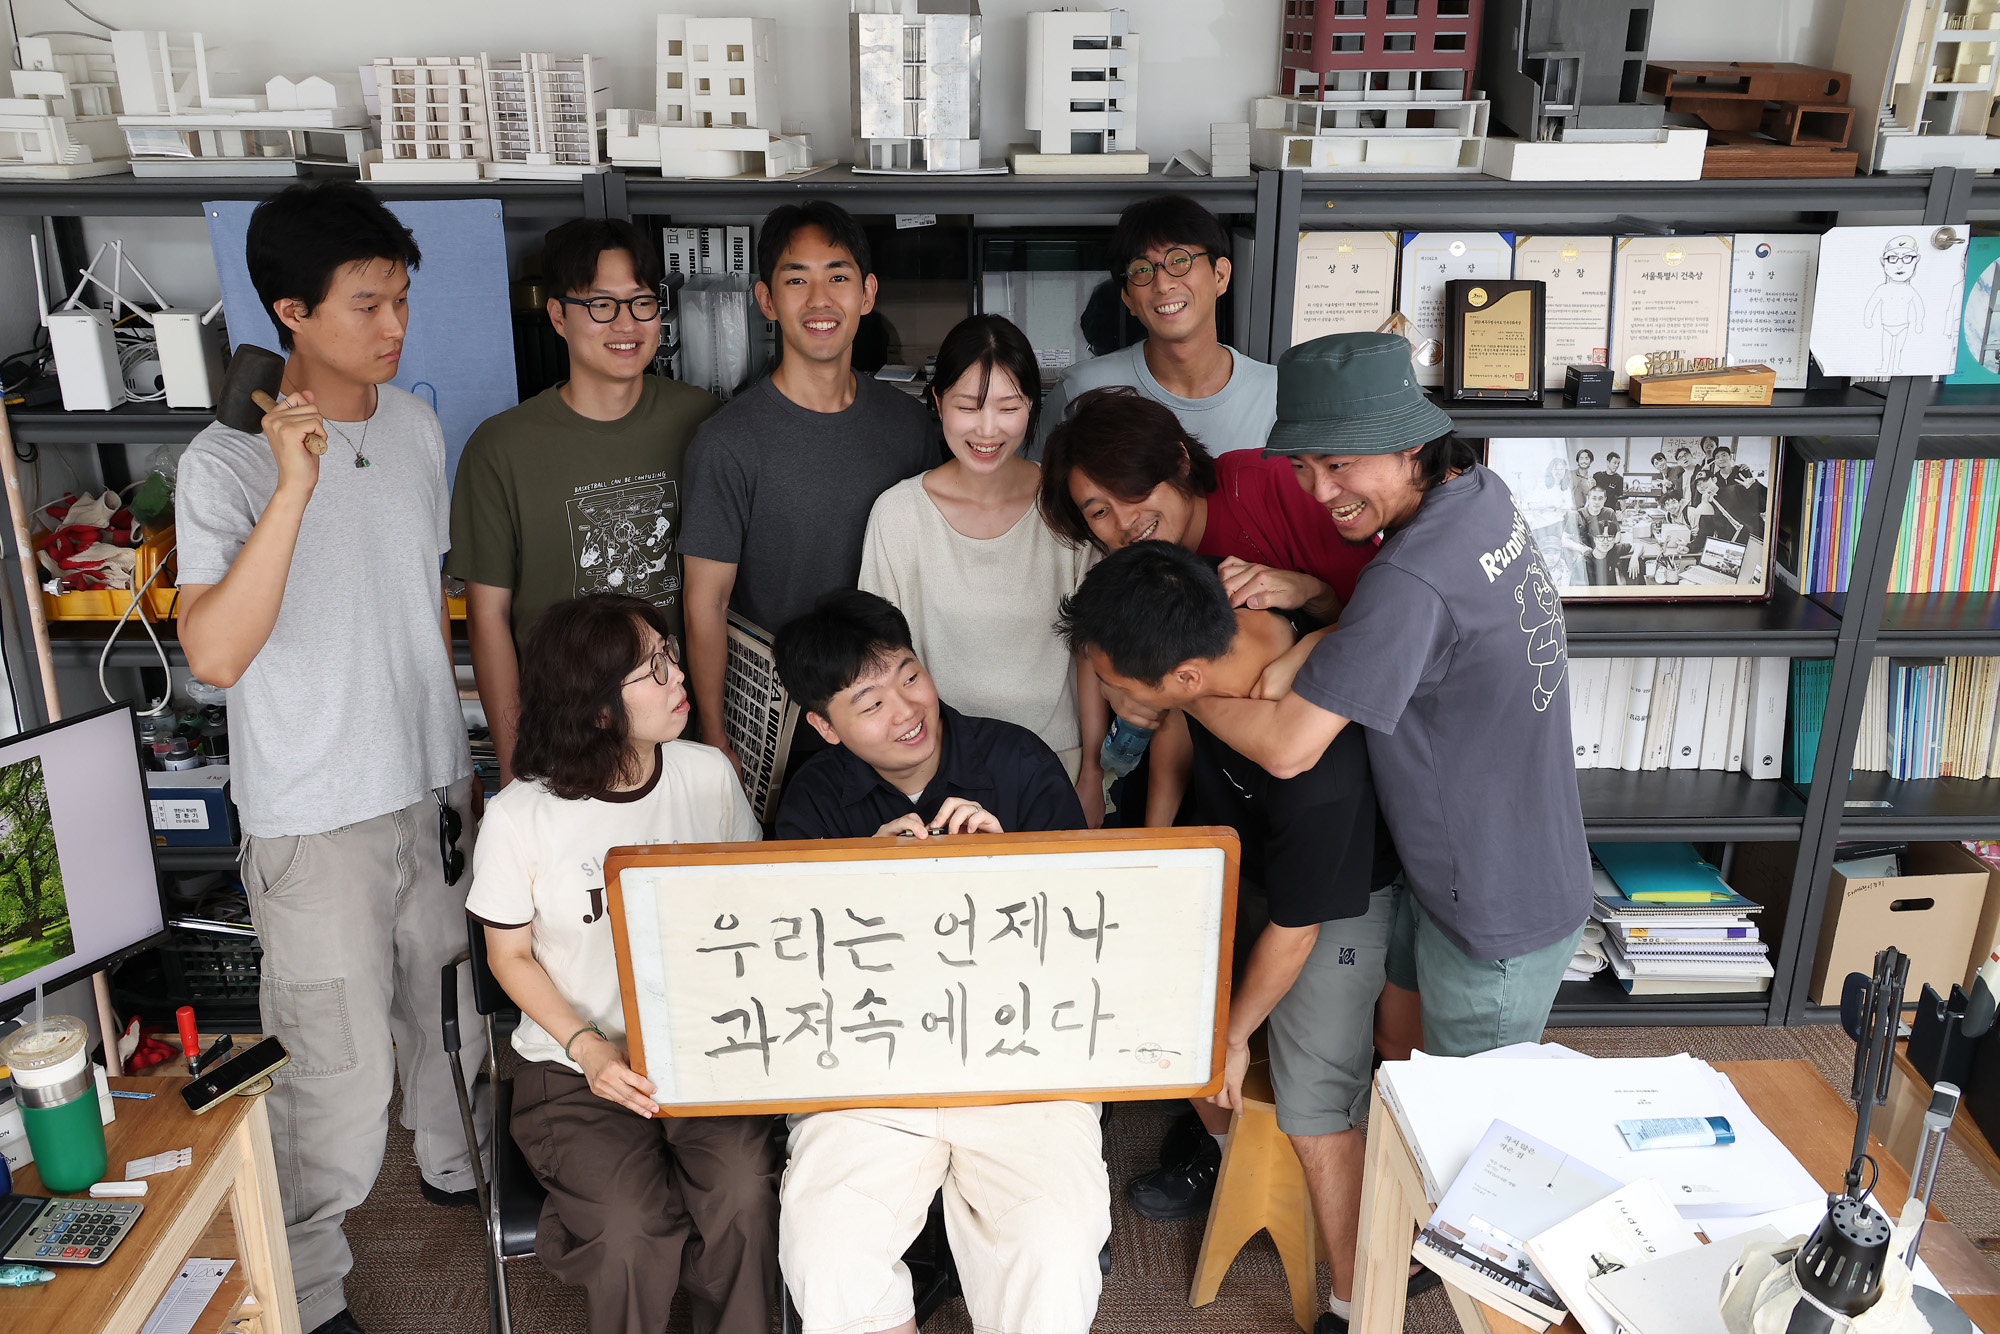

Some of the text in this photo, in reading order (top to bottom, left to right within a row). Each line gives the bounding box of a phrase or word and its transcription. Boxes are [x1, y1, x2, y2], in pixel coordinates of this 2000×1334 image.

[733, 236, 744, 271] REHAU
[1328, 264, 1360, 274] 상 장
[1438, 264, 1475, 273] 상 장
[1552, 268, 1585, 278] 상 장
[1641, 271, 1703, 281] 서울특별시 건축상
[1748, 271, 1775, 280] 상 장
[574, 482, 607, 493] BASKETBALL
[635, 471, 666, 480] CONFUSING
[753, 705, 781, 820] DOCUMENT
[696, 890, 1120, 981] 우리는 언제나
[1615, 1199, 1657, 1253] ludwig
